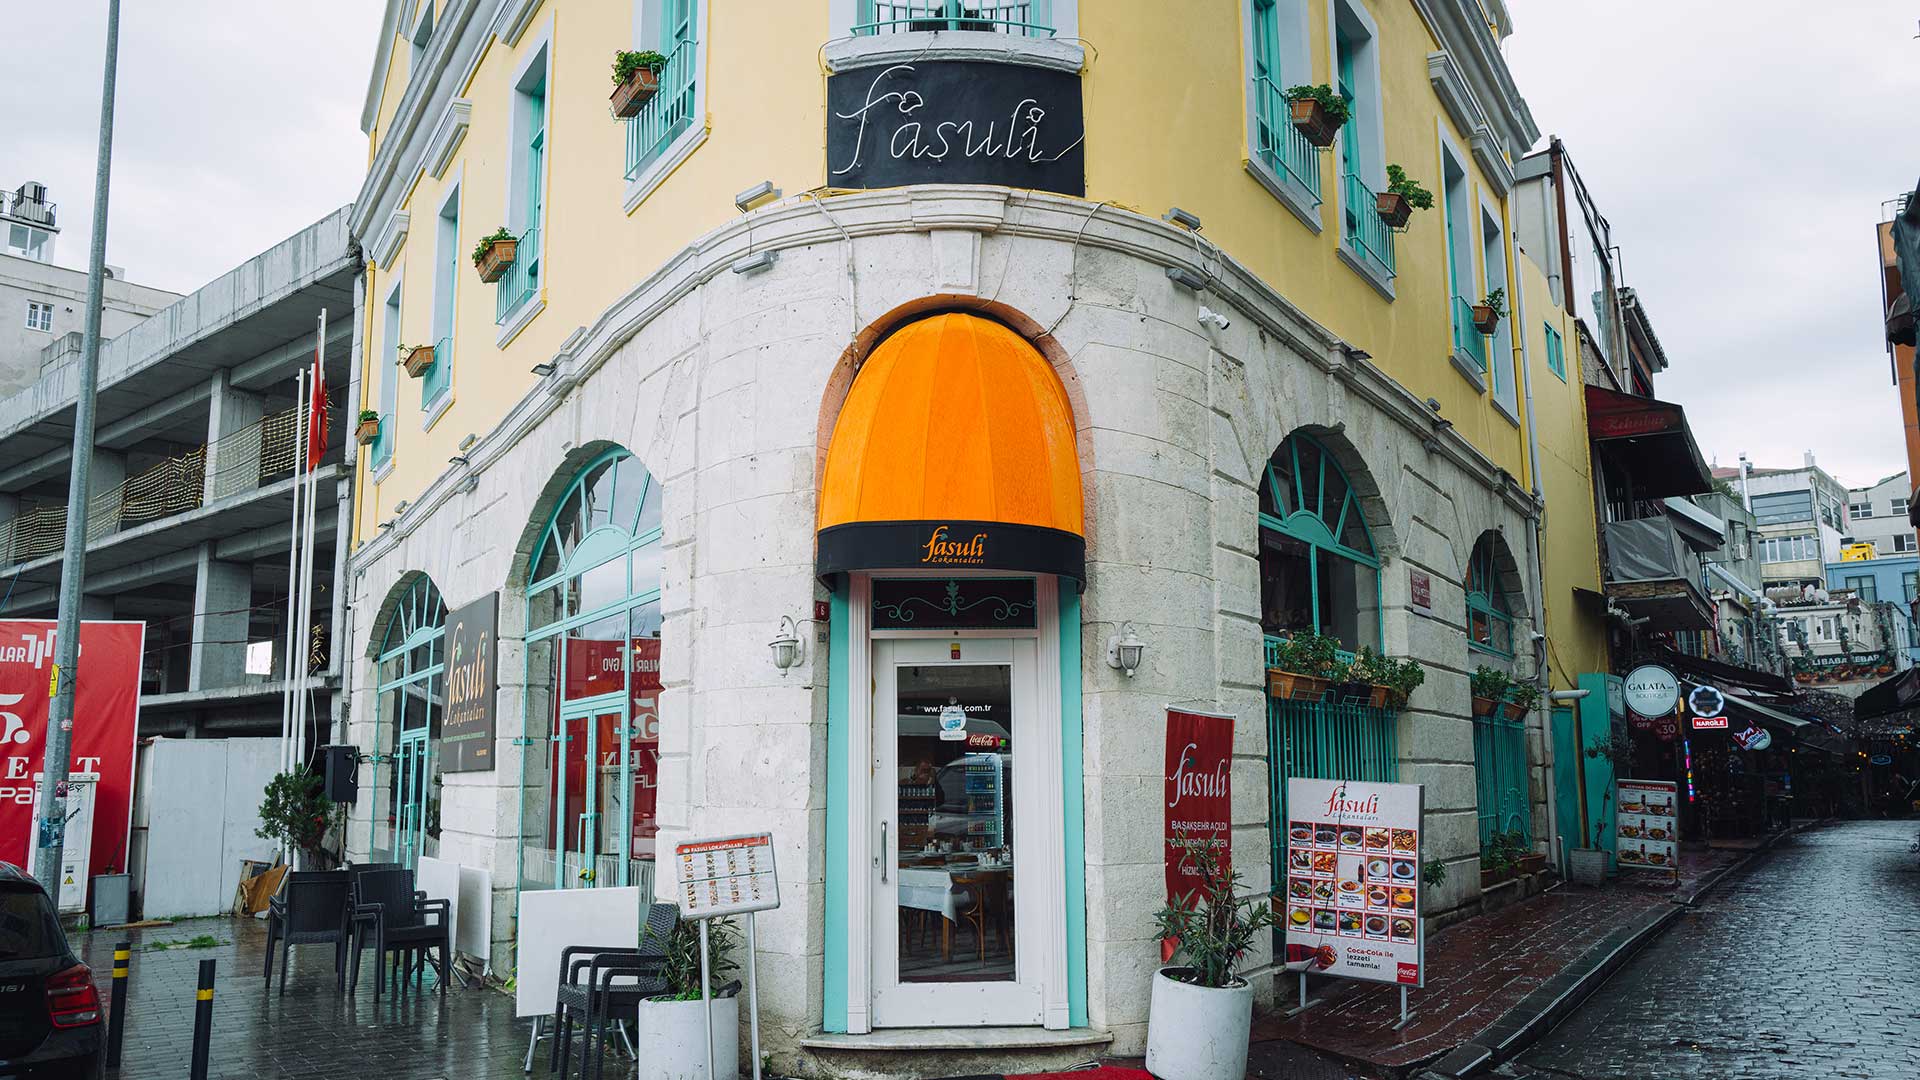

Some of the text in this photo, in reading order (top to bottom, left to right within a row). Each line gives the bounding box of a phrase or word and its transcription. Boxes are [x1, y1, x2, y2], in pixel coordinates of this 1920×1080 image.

[832, 65, 1044, 174] fasuli
[922, 525, 985, 562] fasuli
[444, 622, 487, 726] fasuli
[1628, 683, 1666, 691] GALATA
[1169, 743, 1228, 808] fasuli
[1324, 785, 1378, 816] fasuli
[1347, 947, 1383, 957] Coca-Cola
